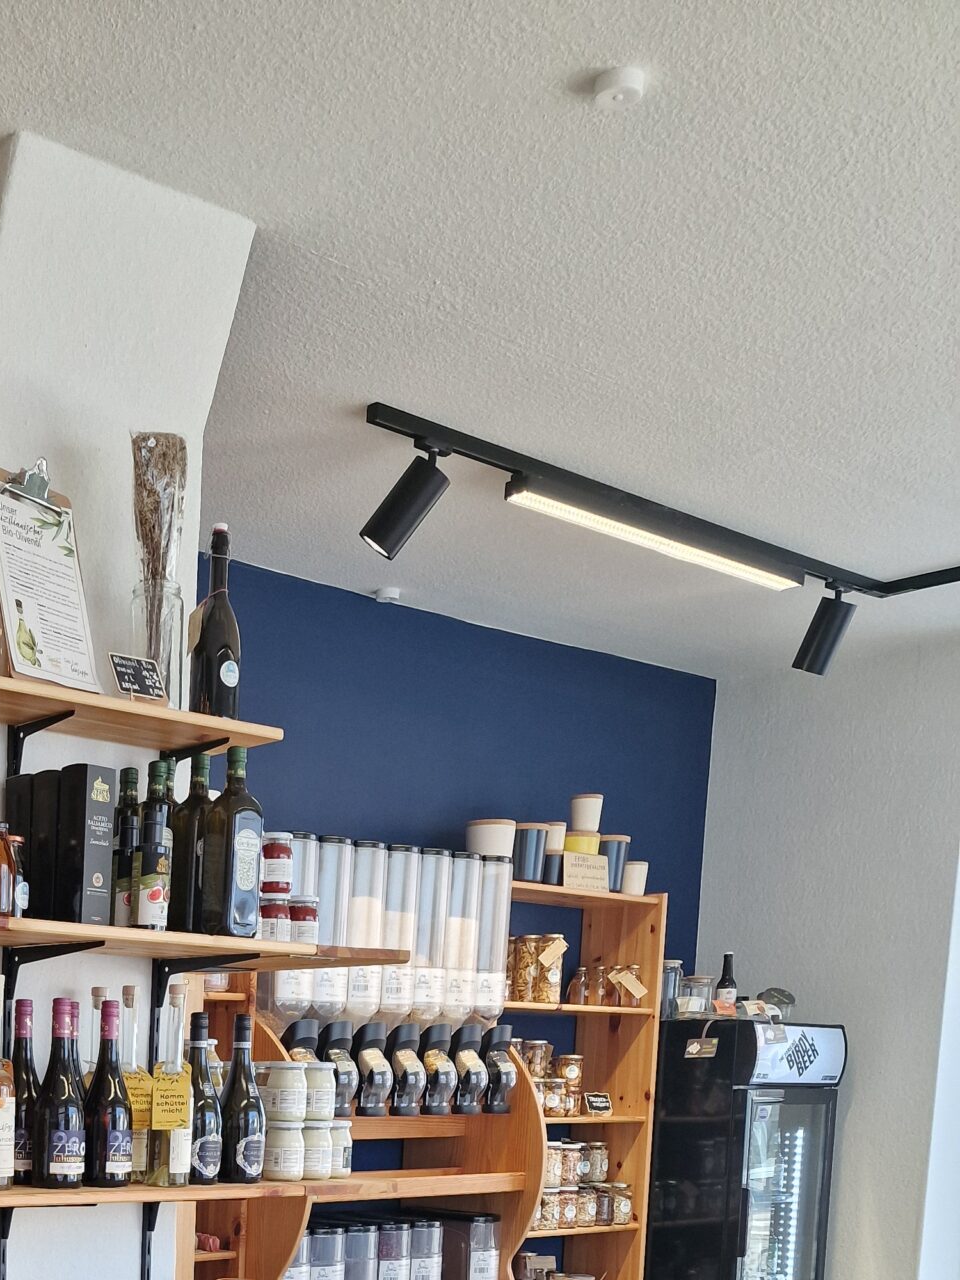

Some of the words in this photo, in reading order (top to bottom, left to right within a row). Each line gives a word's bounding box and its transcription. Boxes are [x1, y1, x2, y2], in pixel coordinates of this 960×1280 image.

[785, 1029, 811, 1071] BIRDY
[796, 1042, 820, 1078] BEER
[53, 1143, 86, 1156] ZERO
[109, 1143, 133, 1156] ZER
